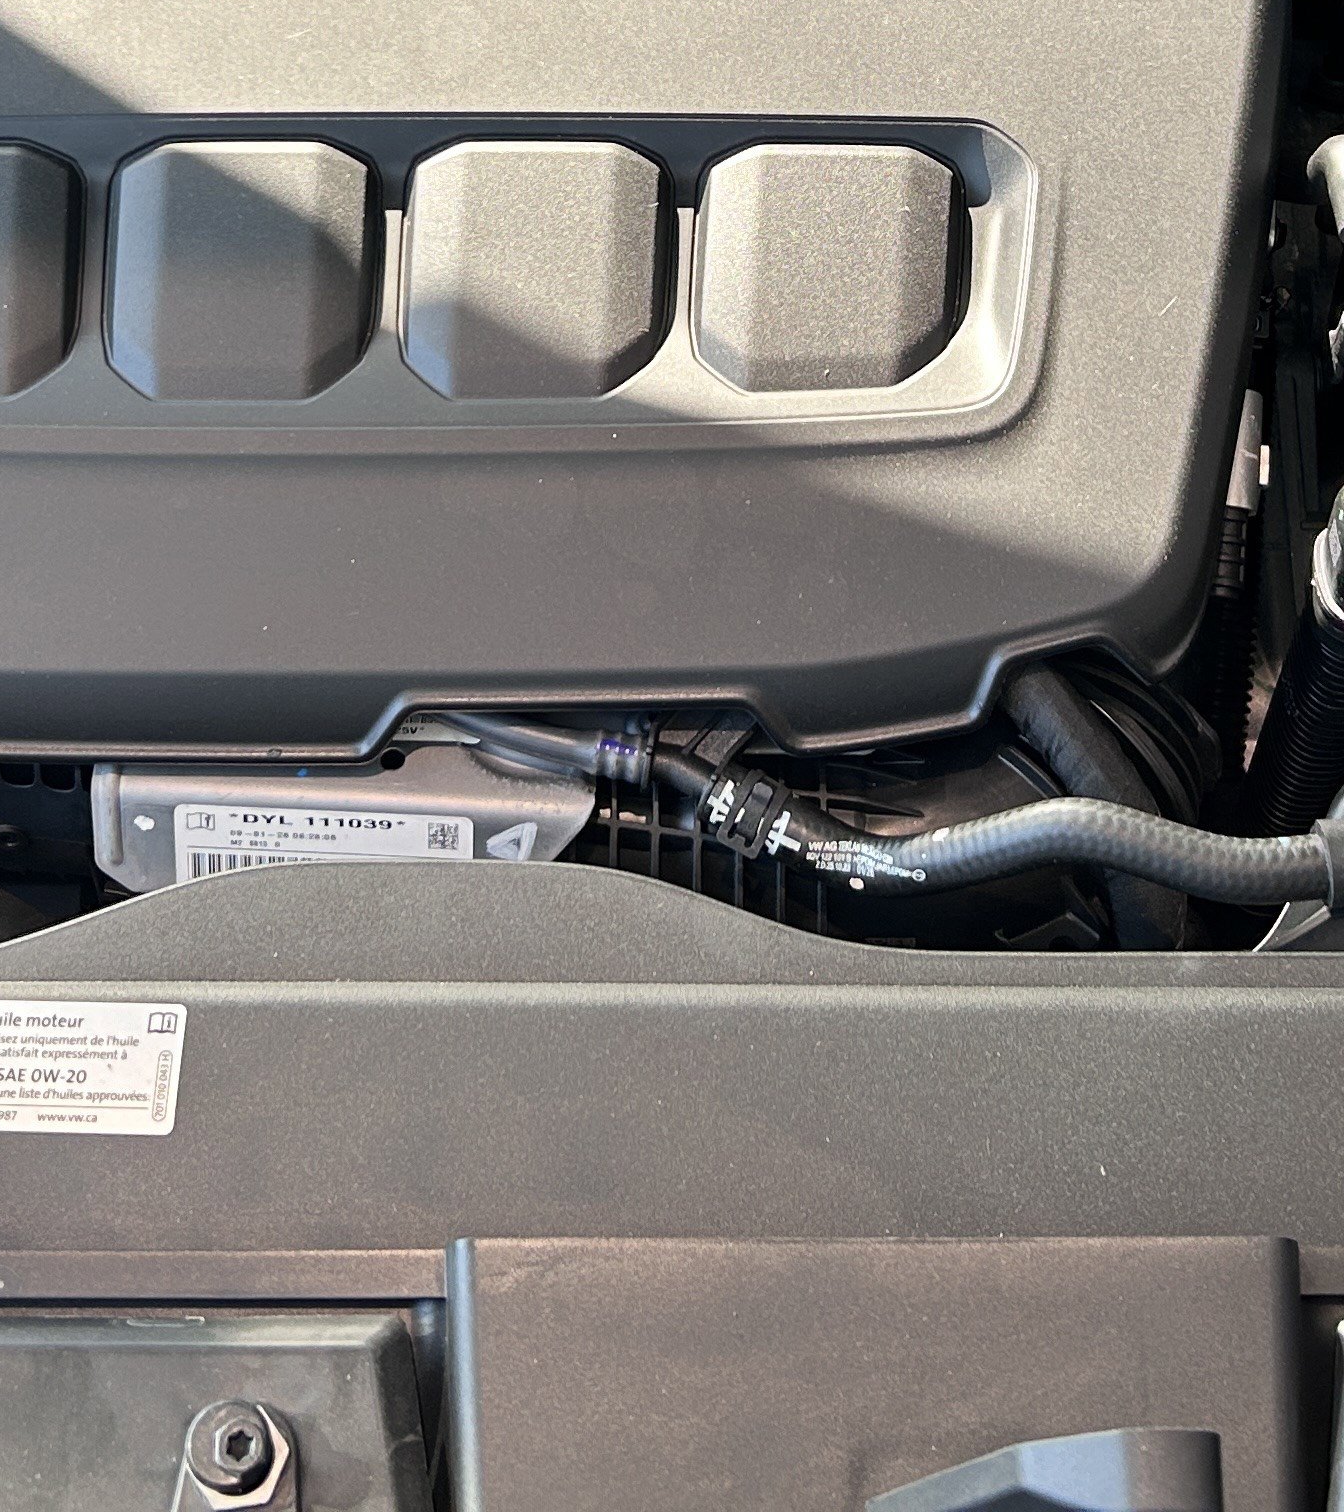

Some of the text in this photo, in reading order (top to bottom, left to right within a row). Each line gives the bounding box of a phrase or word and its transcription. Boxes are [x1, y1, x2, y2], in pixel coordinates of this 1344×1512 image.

[26, 1014, 85, 1028] moteur
[20, 1034, 88, 1046] uniquement
[90, 1035, 104, 1046] de
[106, 1035, 140, 1046] l'huile
[41, 1048, 118, 1062] expressément
[121, 1049, 128, 1059] à
[31, 1068, 87, 1083] 0W-20
[19, 1087, 40, 1099] liste
[43, 1088, 84, 1100] d'huiles
[37, 1112, 98, 1122] www.vw.ca
